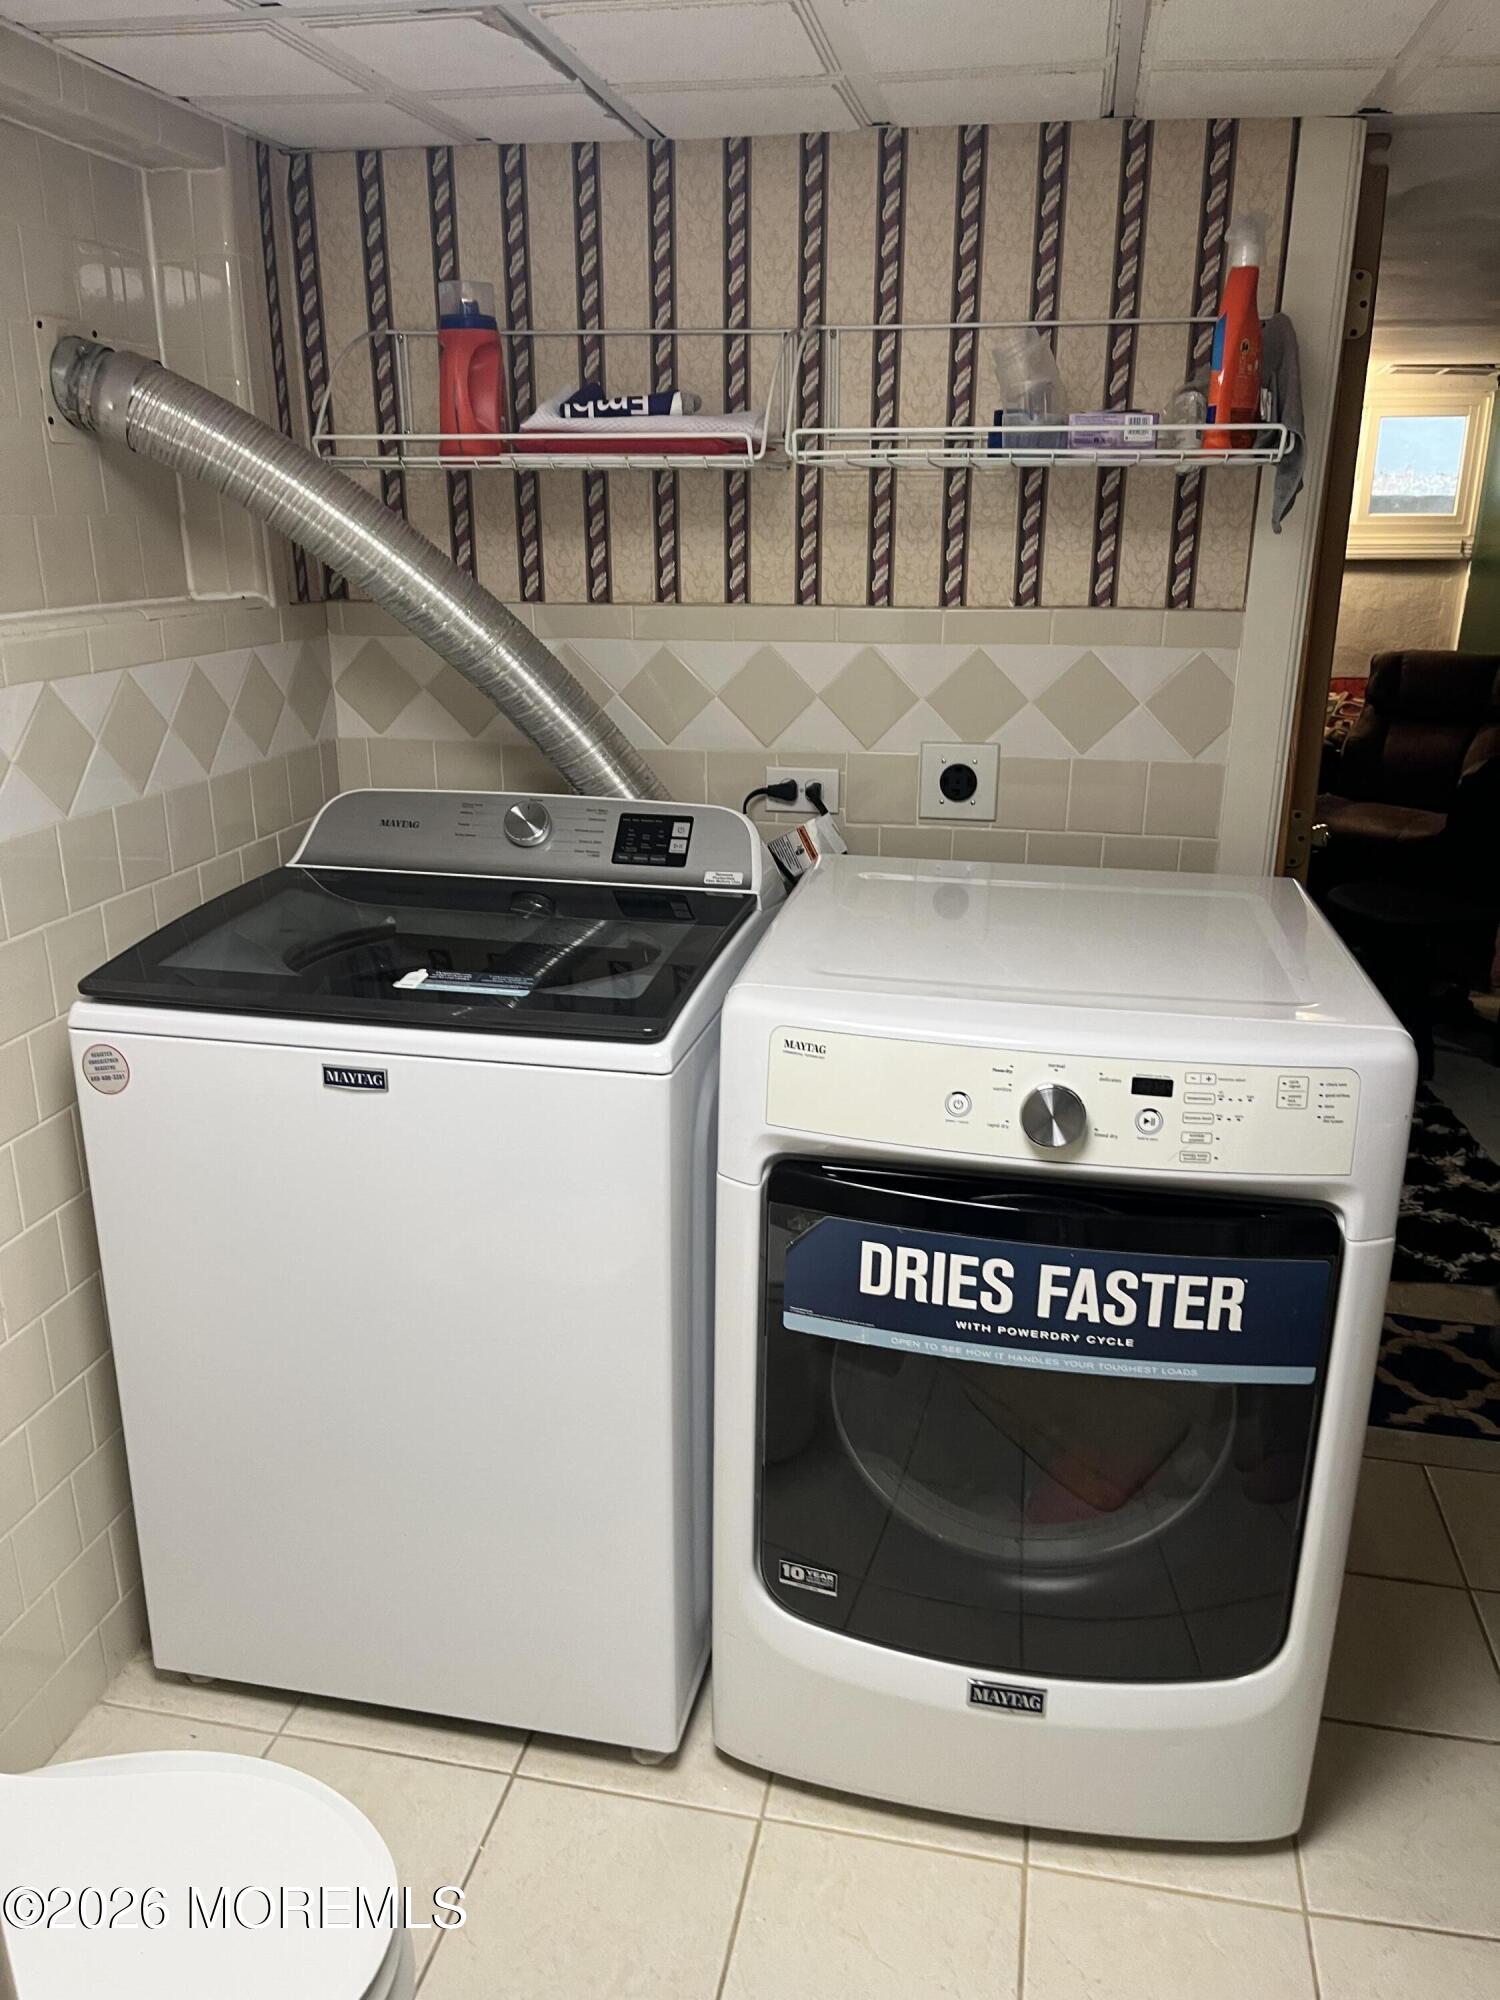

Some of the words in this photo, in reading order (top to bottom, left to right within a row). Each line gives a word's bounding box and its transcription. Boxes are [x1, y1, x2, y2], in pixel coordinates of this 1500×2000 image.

[380, 819, 420, 829] MAYTAG
[784, 1039, 826, 1054] MAYTAG
[326, 1070, 383, 1086] MAYTAG
[859, 1240, 1015, 1315] DRIES
[1037, 1263, 1246, 1332] FASTER
[955, 1320, 992, 1333] WITH
[997, 1325, 1081, 1343] POWERDRY
[1086, 1335, 1135, 1348] CYCLE
[891, 1336, 921, 1348] OPEN
[924, 1342, 938, 1351] TO
[942, 1345, 962, 1355] SEE
[966, 1348, 993, 1358] HOW
[994, 1351, 1005, 1360] IT
[1007, 1353, 1059, 1366] HANDLES
[1063, 1360, 1095, 1370] YOUR
[1099, 1363, 1159, 1375] TOUGHEST
[1161, 1367, 1199, 1377] LOADS
[782, 1563, 805, 1580] 10
[805, 1569, 835, 1582] YEAR
[972, 1686, 1042, 1710] MAYTAG
